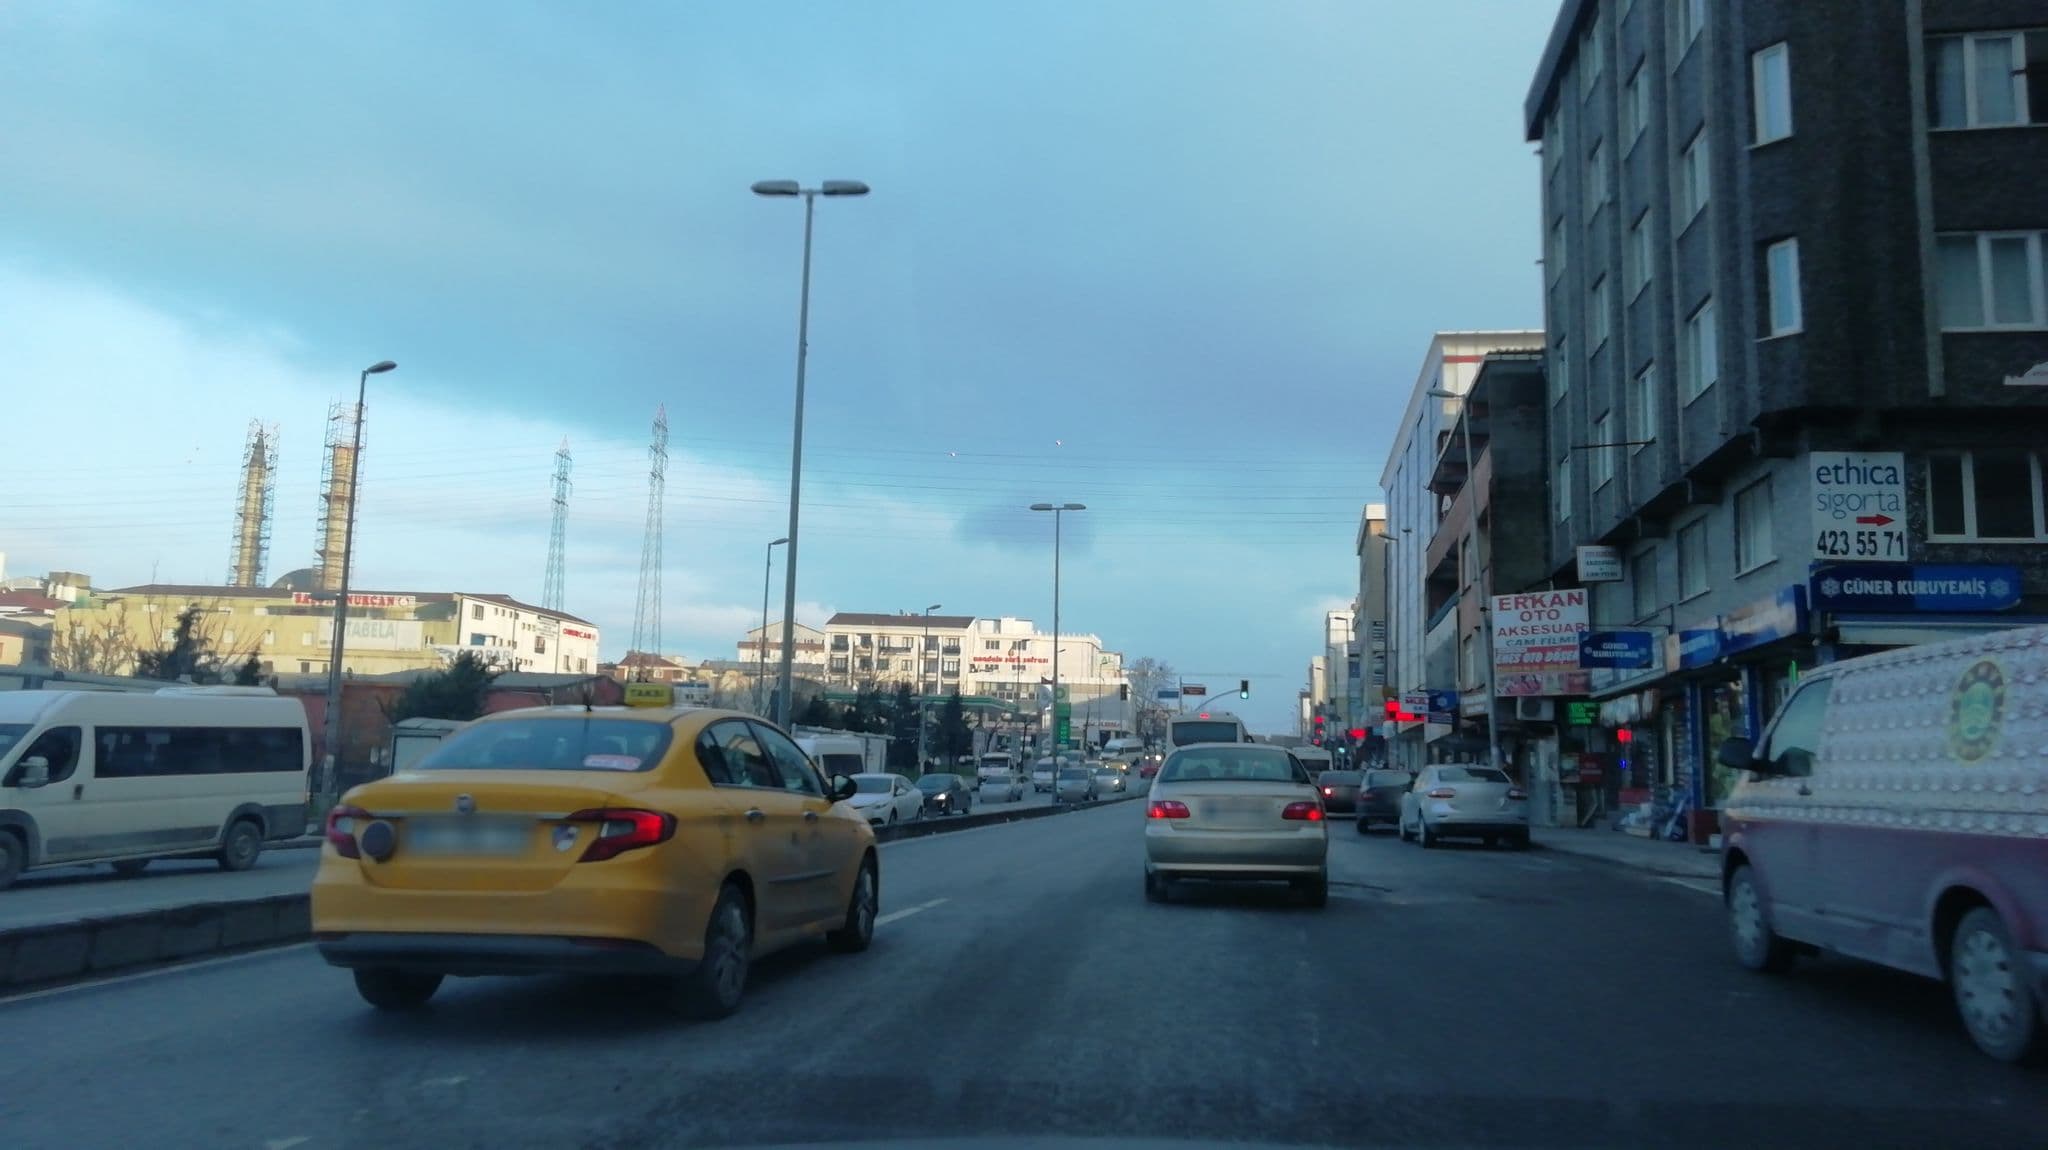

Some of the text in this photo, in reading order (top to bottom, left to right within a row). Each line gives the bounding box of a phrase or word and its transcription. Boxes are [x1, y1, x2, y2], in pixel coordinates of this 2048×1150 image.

[1816, 457, 1899, 485] ethica
[1816, 489, 1901, 520] sigorta
[1817, 530, 1905, 557] 423 55 71
[1843, 577, 1987, 598] GÜNER KURUYEMİŞ
[1498, 591, 1584, 611] ERKAN
[1520, 609, 1561, 623] OTO
[1497, 623, 1586, 638] AKSESUAR
